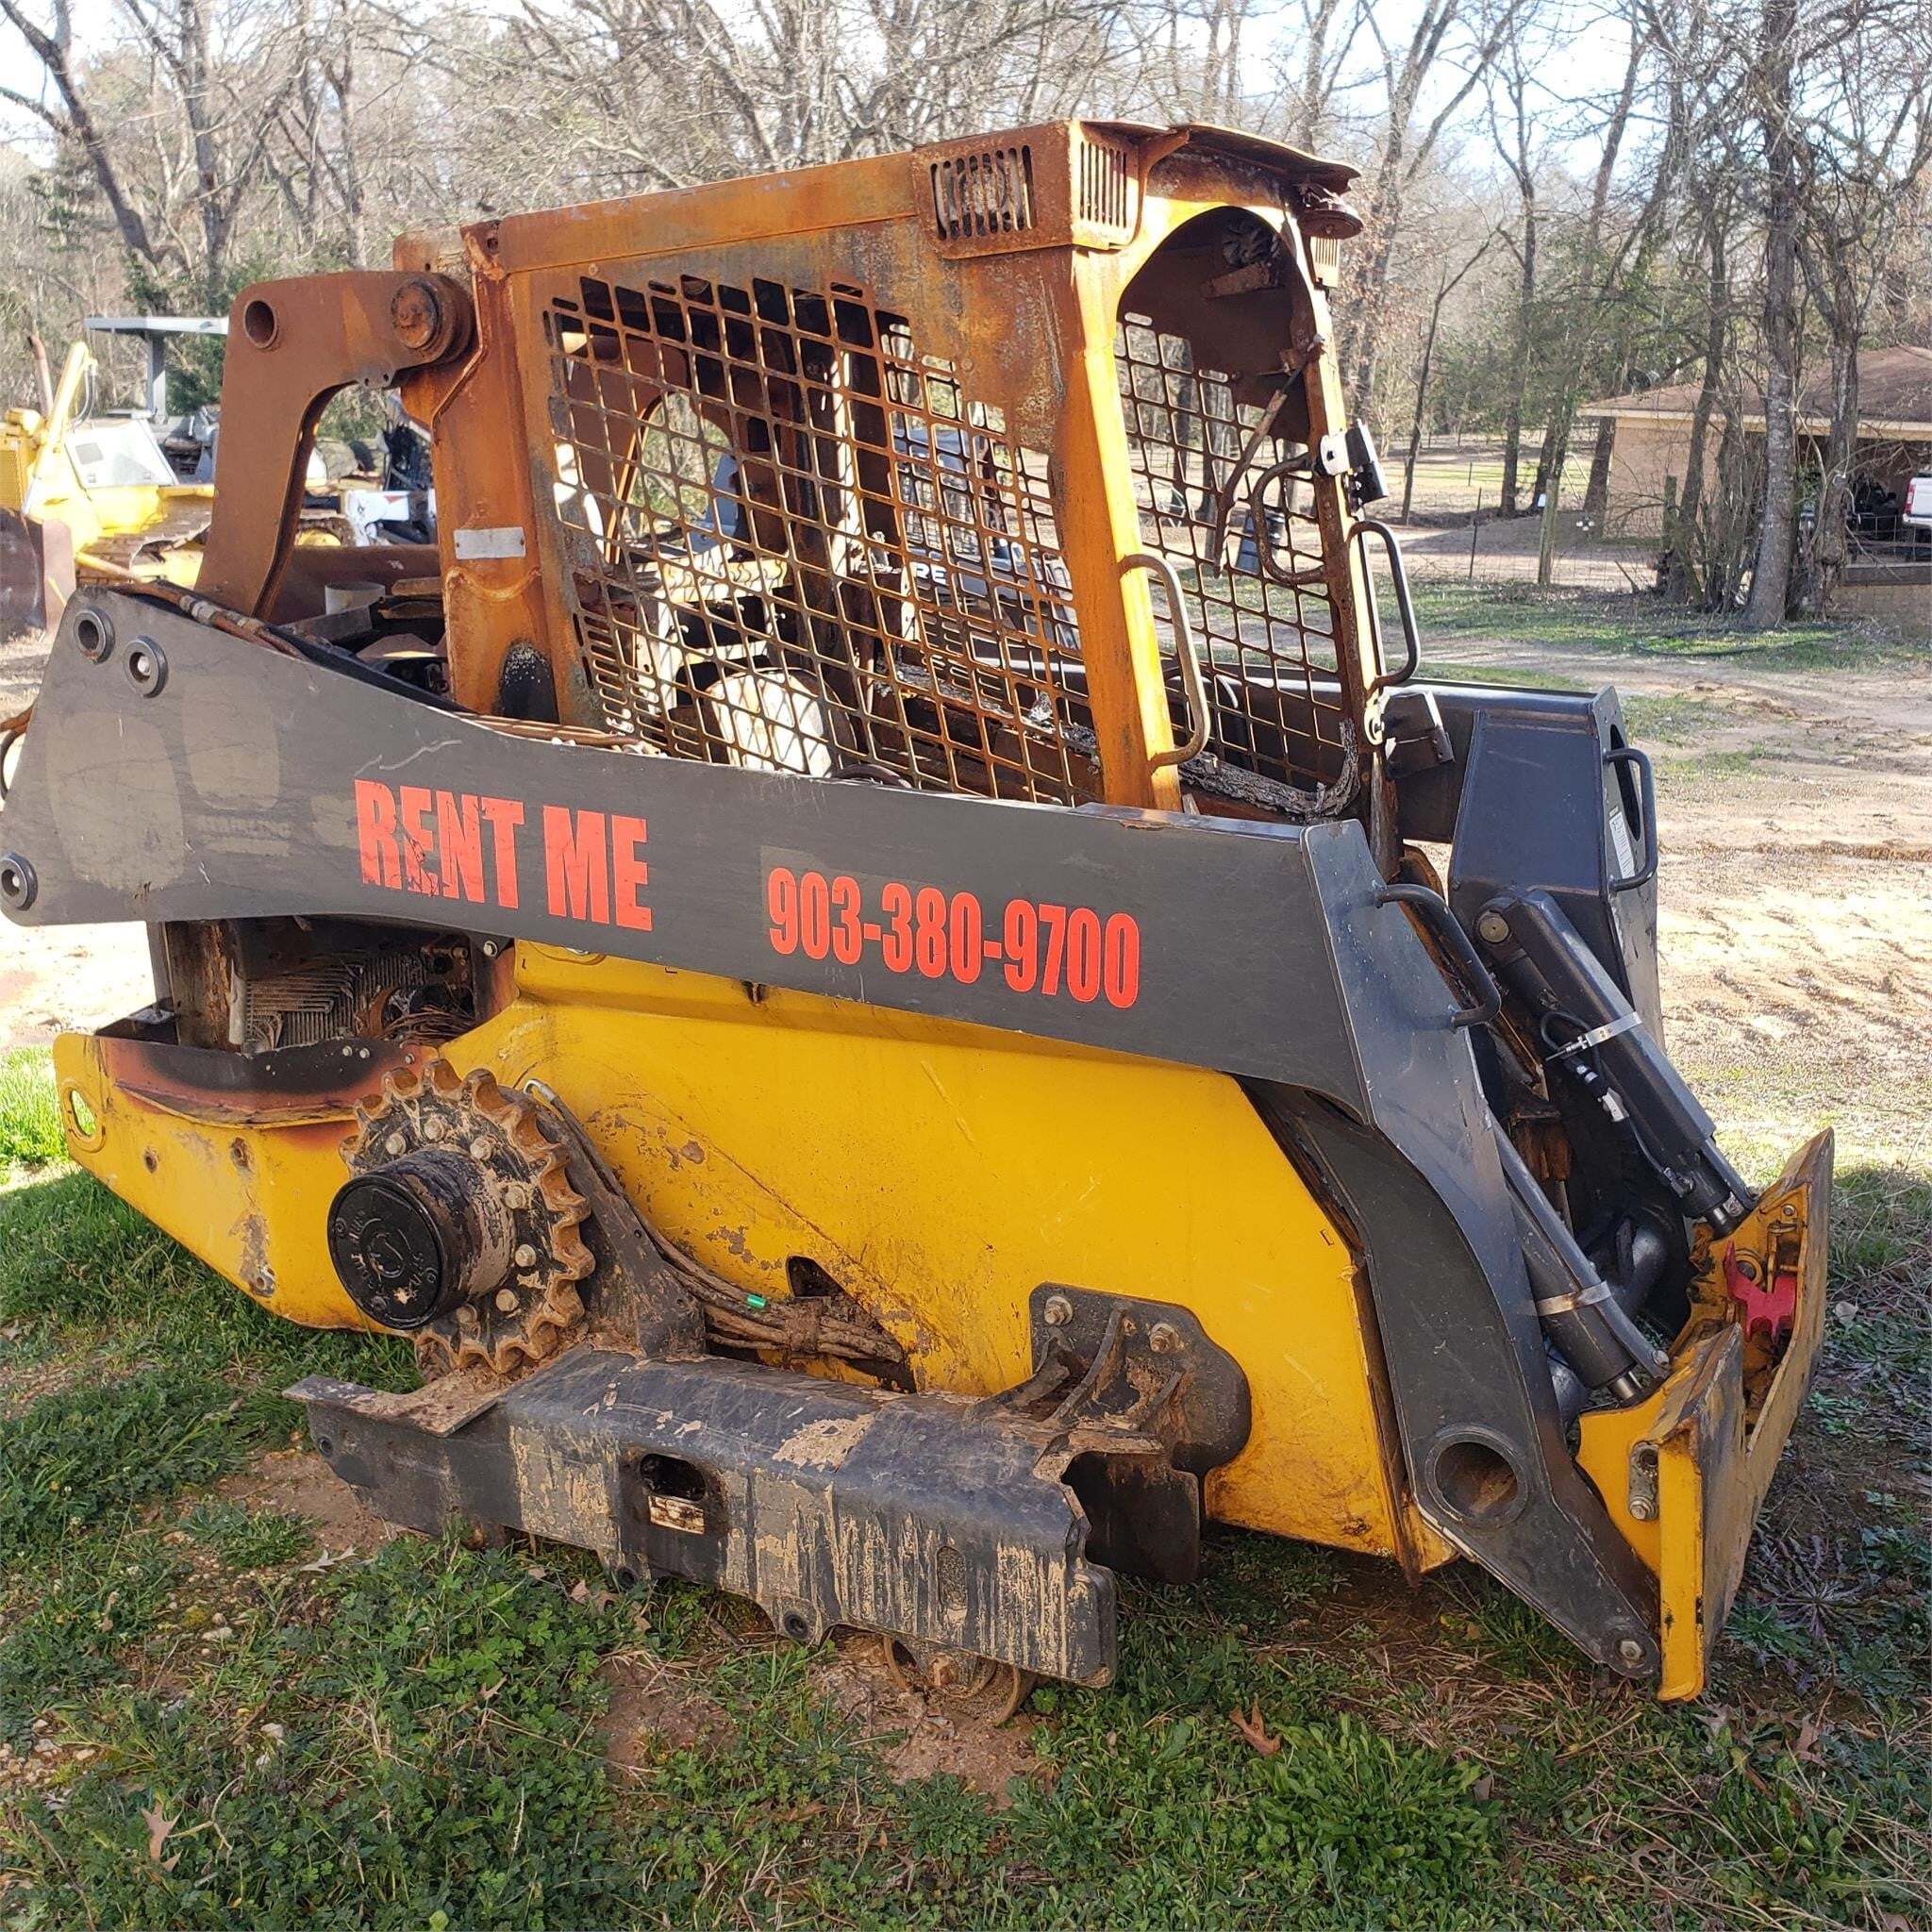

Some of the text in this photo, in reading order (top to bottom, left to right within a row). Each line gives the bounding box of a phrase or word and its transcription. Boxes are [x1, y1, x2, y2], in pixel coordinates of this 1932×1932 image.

[355, 779, 653, 932] RENT ME
[767, 867, 1141, 1009] 903-380-9700
